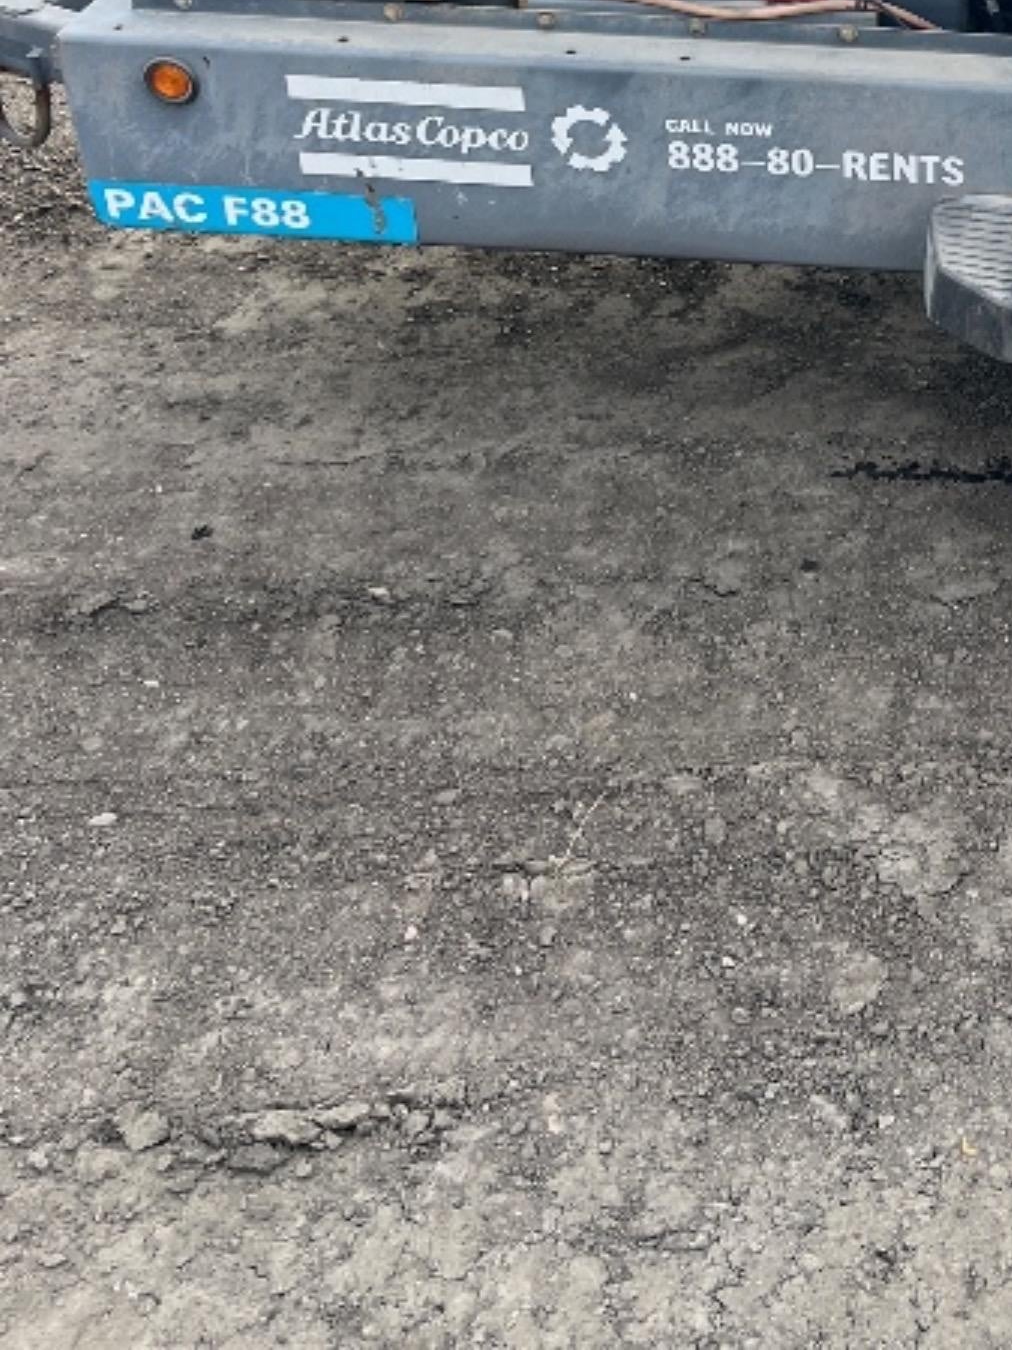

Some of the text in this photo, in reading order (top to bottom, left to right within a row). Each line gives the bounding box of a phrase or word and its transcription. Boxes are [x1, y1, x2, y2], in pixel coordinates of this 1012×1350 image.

[294, 107, 529, 154] Atlas Copco
[665, 119, 772, 136] CALL NOW
[668, 141, 964, 186] 888-80-RENTS
[103, 188, 310, 228] PAC F88
